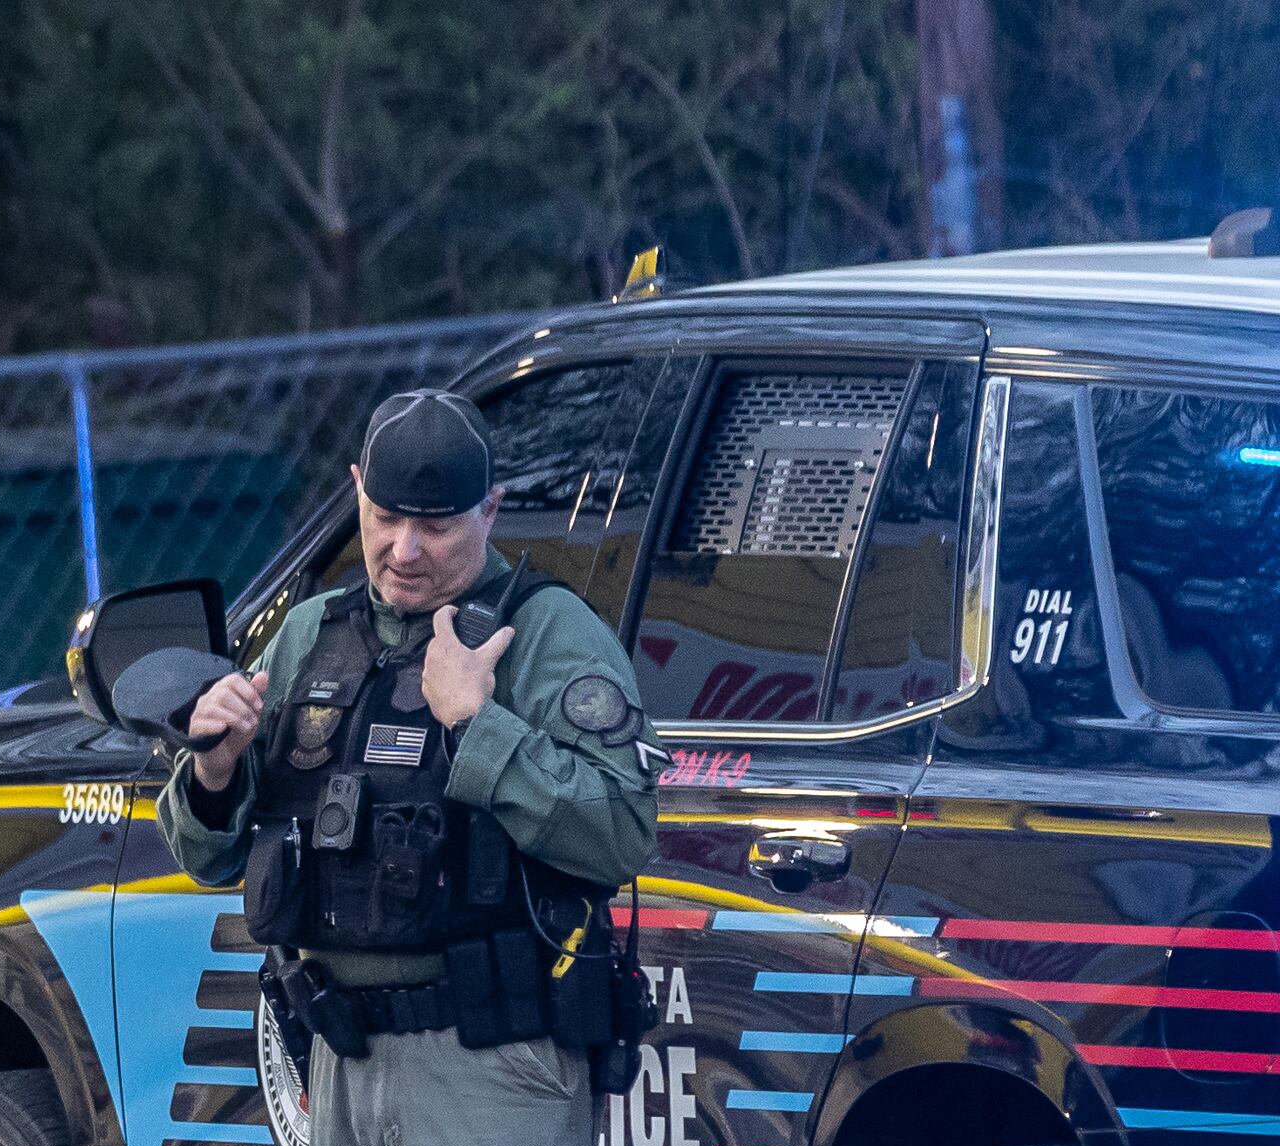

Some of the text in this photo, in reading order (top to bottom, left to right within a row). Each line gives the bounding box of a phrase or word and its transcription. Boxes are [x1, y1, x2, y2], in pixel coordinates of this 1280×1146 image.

[1024, 589, 1072, 614] DIAL
[1010, 618, 1069, 665] 911
[701, 751, 752, 788] K-9
[59, 783, 124, 825] 35689
